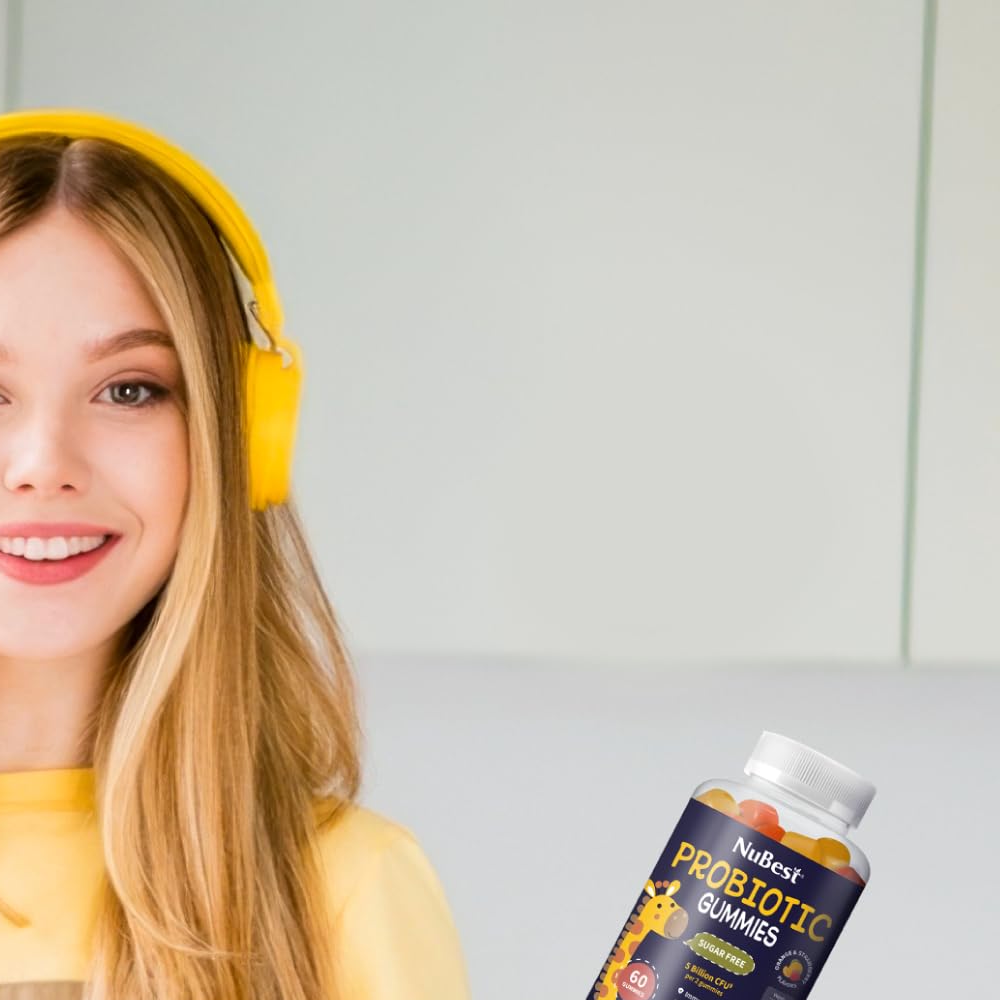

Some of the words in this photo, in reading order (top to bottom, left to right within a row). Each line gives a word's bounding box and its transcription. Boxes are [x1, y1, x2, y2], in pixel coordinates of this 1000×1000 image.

[732, 836, 803, 885] NuBest
[671, 841, 832, 942] PROBIOTIC
[698, 892, 780, 948] GUMMIES
[698, 940, 725, 957] SUGAR
[725, 953, 747, 969] FREE
[775, 951, 793, 971] ORANGE
[629, 970, 648, 988] 60
[685, 962, 692, 970] 5
[691, 966, 715, 981] Billion
[685, 974, 695, 982] per
[698, 981, 723, 997] gummies
